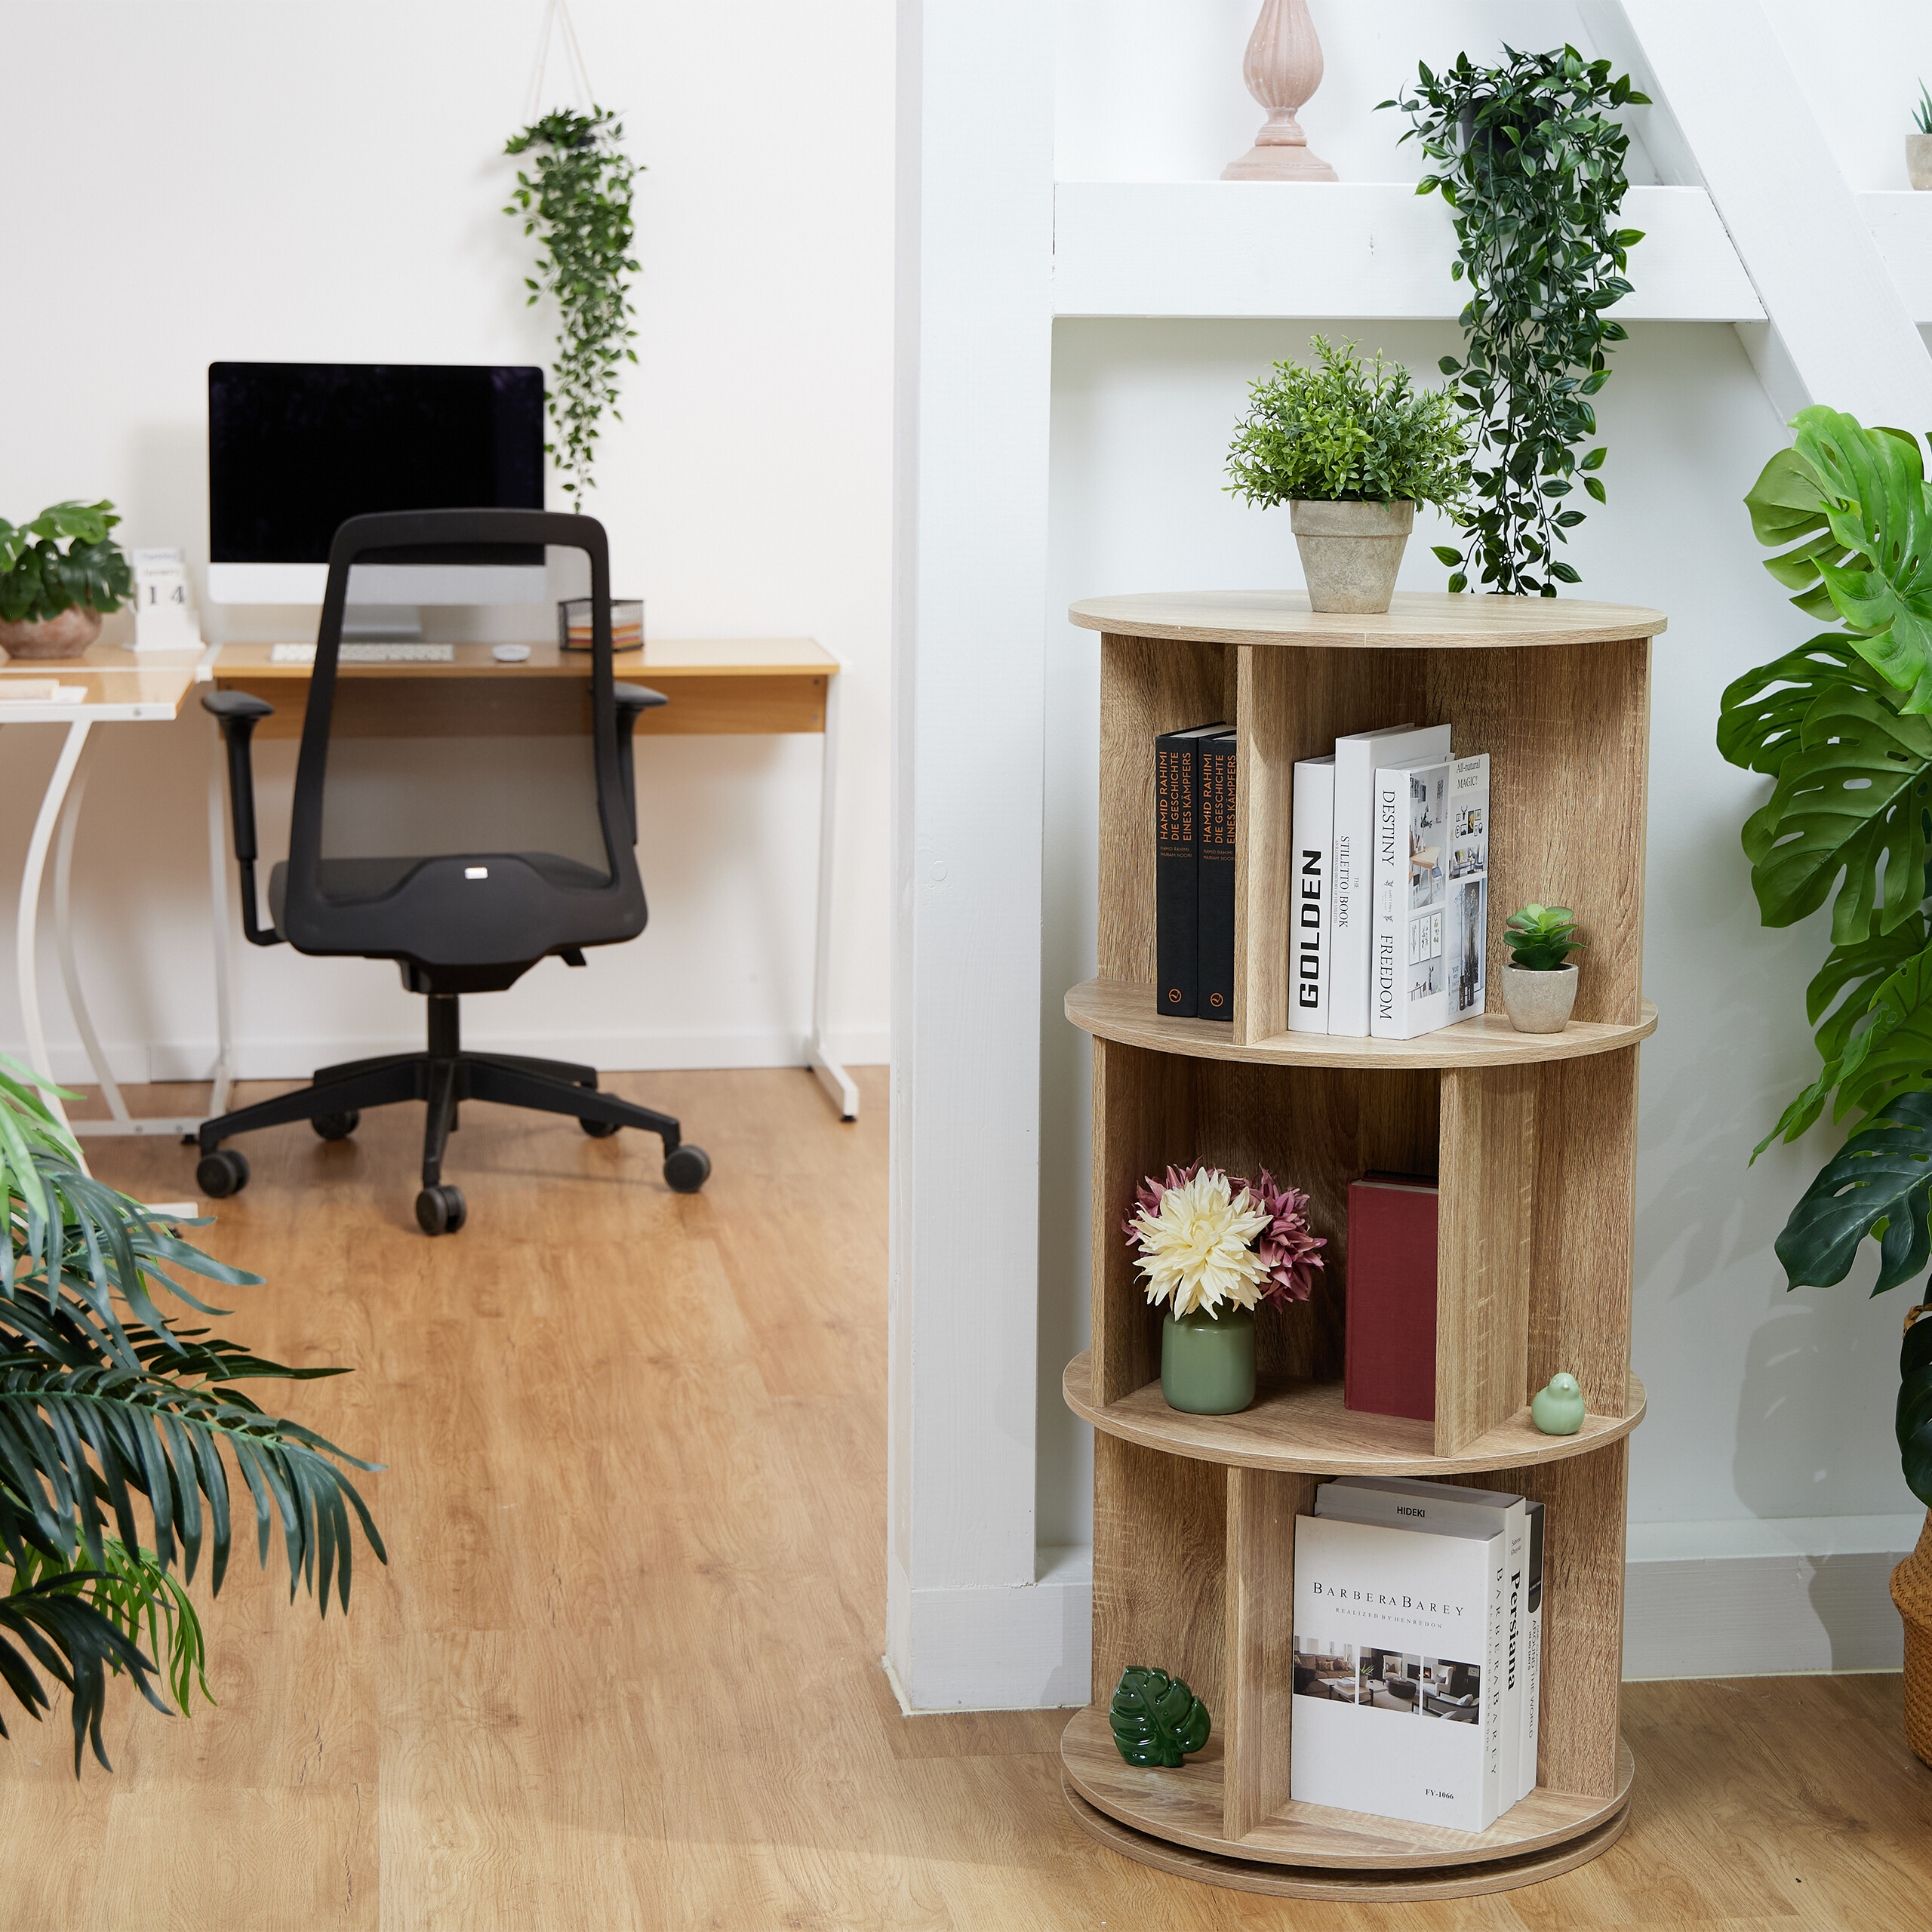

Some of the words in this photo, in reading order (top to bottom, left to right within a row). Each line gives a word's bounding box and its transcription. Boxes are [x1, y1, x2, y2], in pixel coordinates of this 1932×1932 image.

[1159, 752, 1168, 795] RAHIMI
[1171, 752, 1179, 820] GESCHICHTE
[1181, 752, 1192, 808] KÄMPFERS
[1203, 754, 1212, 798] RAHIMI
[1226, 755, 1236, 811] KÄMPFERS
[1456, 759, 1481, 774] All-natural
[1457, 776, 1478, 789] MAGIC!
[1215, 755, 1224, 823] GESCHICHTE
[1160, 799, 1168, 840] HAMID
[1171, 823, 1180, 841] DIE
[1183, 811, 1192, 841] EINES
[1203, 801, 1212, 843] HAMID
[1214, 826, 1223, 844] DIE
[1227, 814, 1235, 844] EINES
[1382, 789, 1395, 867] DESTINY
[1340, 835, 1350, 890] STILETTO
[1300, 850, 1321, 1009] GOLDEN
[1339, 896, 1349, 928] BOOK
[1380, 934, 1394, 1020] FREEDOM
[1397, 1506, 1426, 1518] HIDEKI
[1335, 1607, 1379, 1620] REALIZED
[1395, 1617, 1443, 1629] HENREDON
[1508, 1569, 1521, 1692] Persiana
[1426, 1789, 1454, 1799] FY-1066
